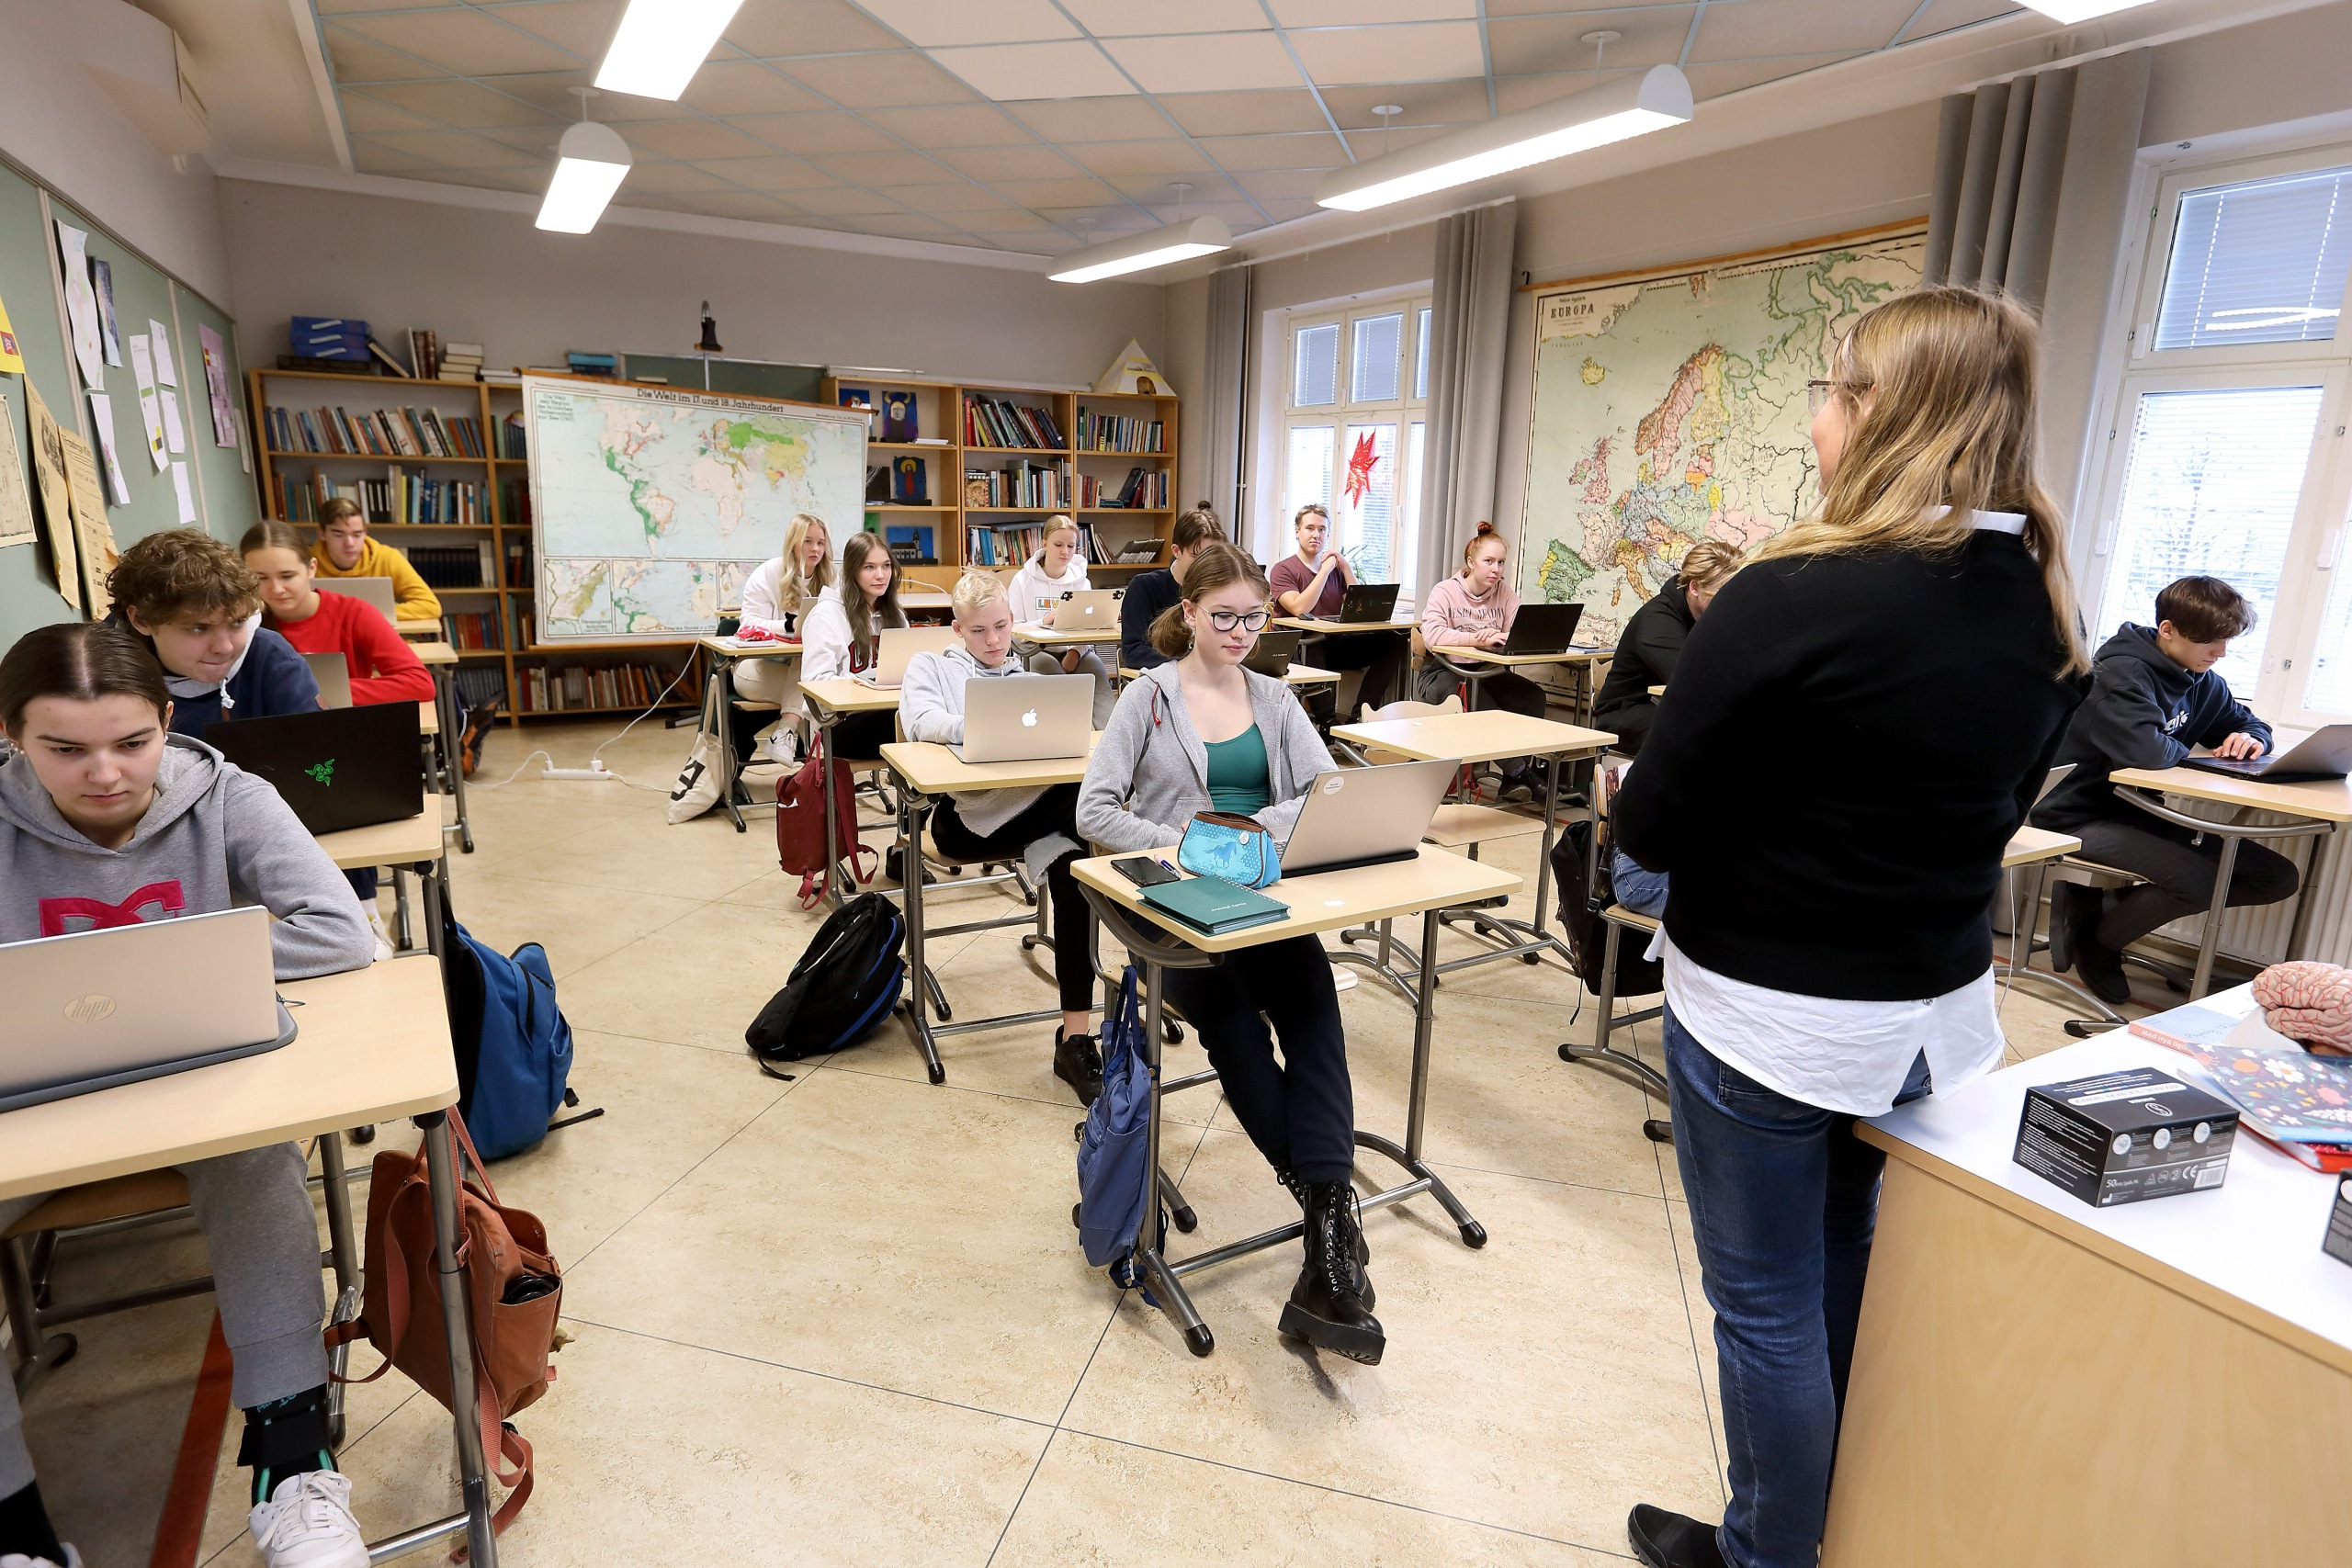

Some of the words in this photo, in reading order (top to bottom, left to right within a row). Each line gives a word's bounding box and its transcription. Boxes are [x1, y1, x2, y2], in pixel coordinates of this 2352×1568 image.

[1551, 303, 1594, 319] EUROPA
[637, 388, 652, 398] Die
[653, 389, 676, 401] Welt
[678, 392, 691, 403] im
[701, 398, 718, 406] und
[732, 400, 784, 412] Jahrhundert
[71, 995, 111, 1023] hp
[2141, 1030, 2157, 1040] Med
[2157, 1036, 2172, 1045] nya
